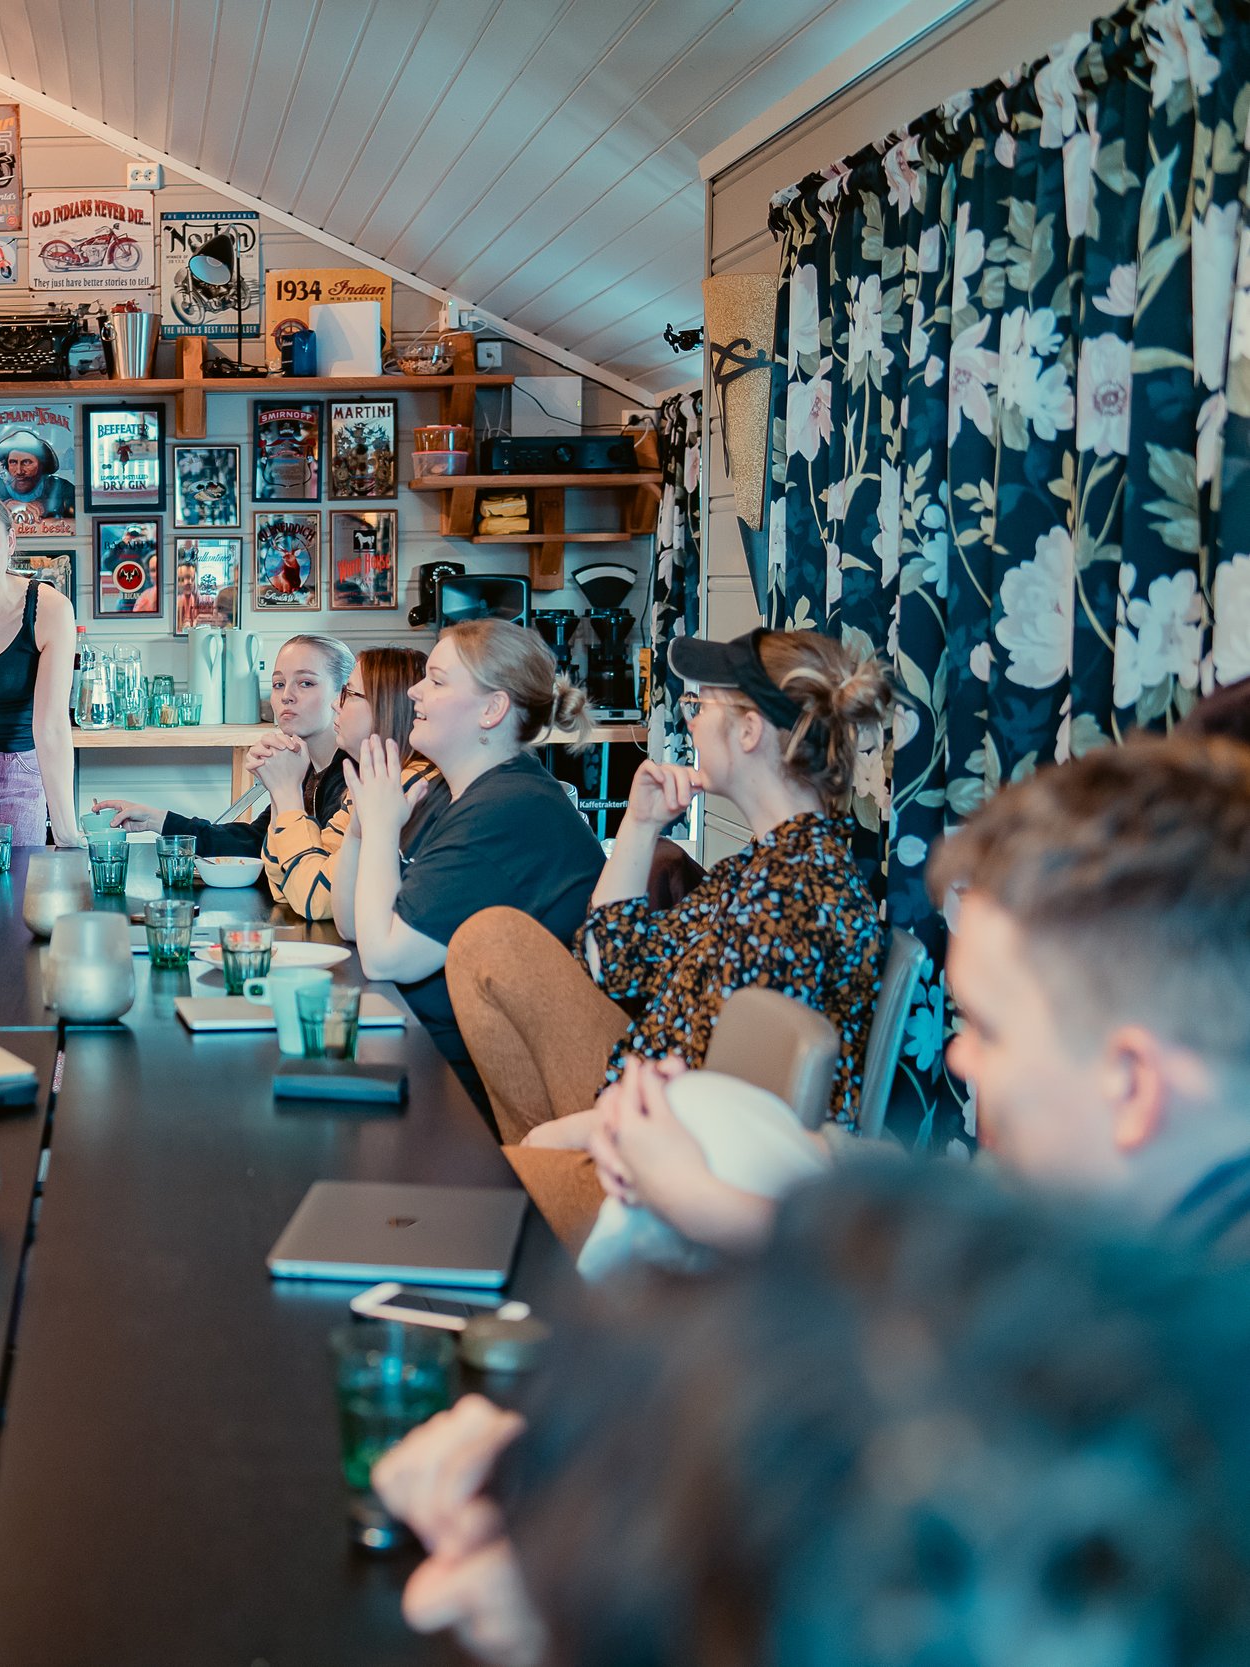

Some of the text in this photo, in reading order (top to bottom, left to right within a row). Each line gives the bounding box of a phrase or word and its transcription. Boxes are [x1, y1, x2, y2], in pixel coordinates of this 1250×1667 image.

[32, 209, 51, 228] OLD
[53, 199, 92, 224] INDIANS
[94, 199, 126, 223] NEVER
[34, 278, 49, 288] They
[51, 278, 64, 288] just
[66, 278, 81, 288] have
[83, 277, 103, 287] better
[104, 277, 128, 286] stories
[129, 277, 136, 286] to
[328, 279, 386, 296] Indian
[276, 280, 322, 301] 1934
[163, 326, 175, 334] THE
[177, 326, 202, 334] WORLD'S
[204, 326, 218, 334] BEST
[261, 411, 313, 422] SMIRNOFF
[334, 406, 390, 419] MARTINI
[97, 423, 150, 438] BEEFEATER
[103, 480, 147, 491] DRY GIN
[17, 522, 37, 534] den
